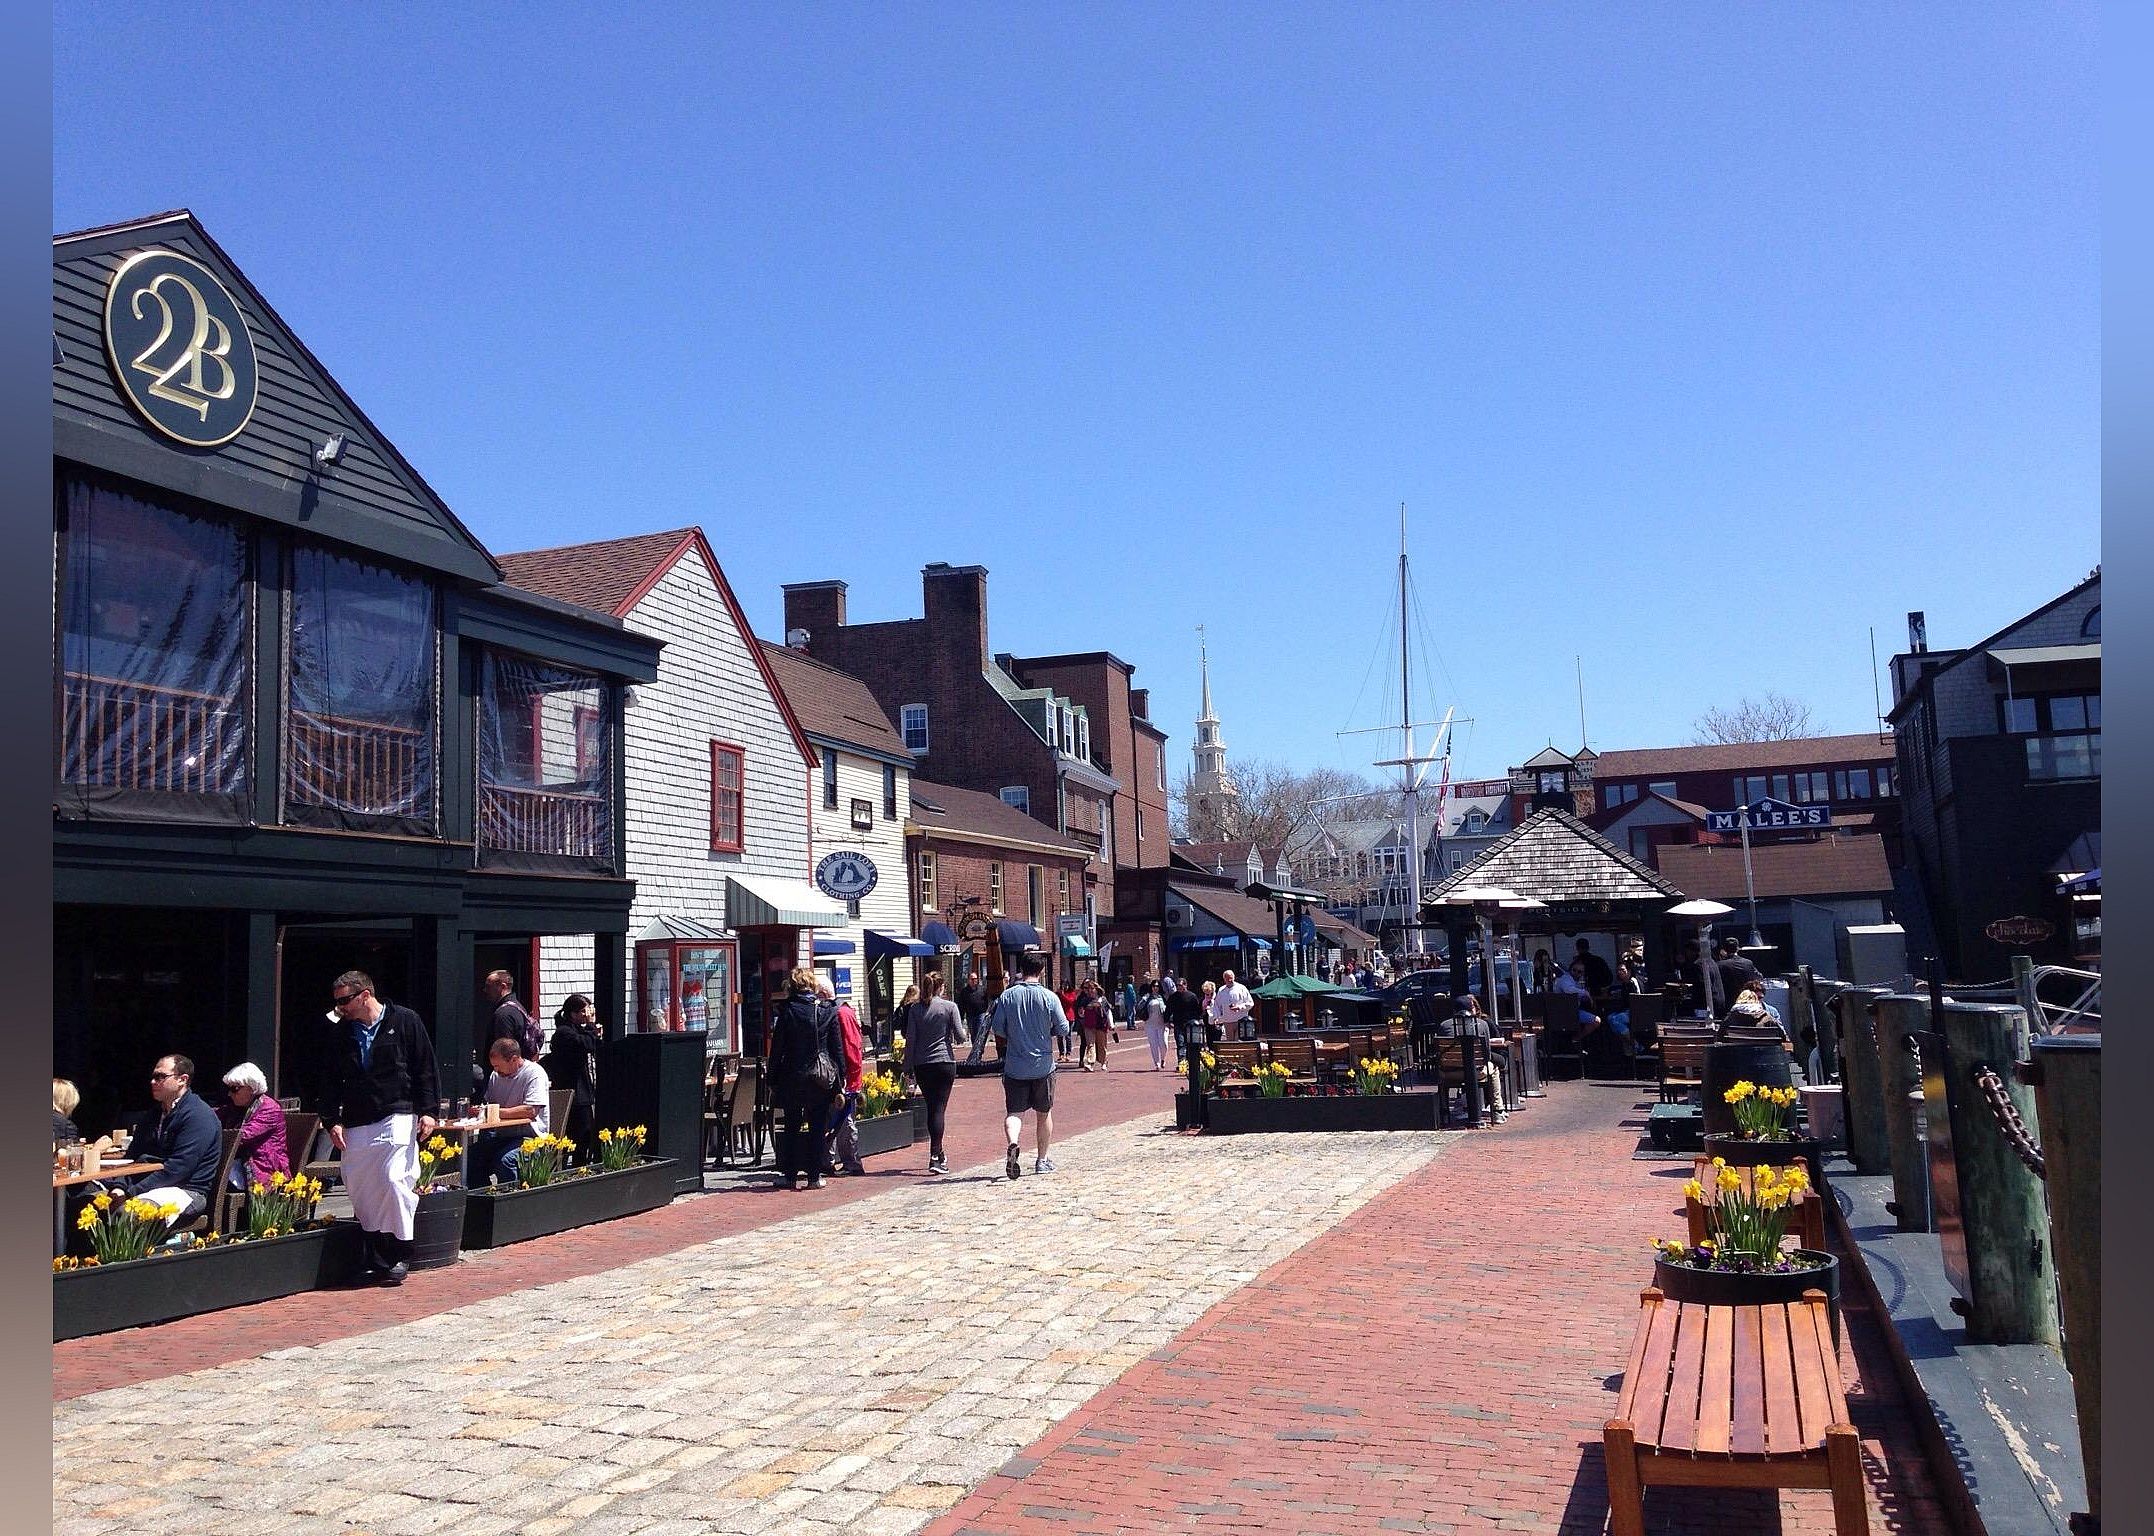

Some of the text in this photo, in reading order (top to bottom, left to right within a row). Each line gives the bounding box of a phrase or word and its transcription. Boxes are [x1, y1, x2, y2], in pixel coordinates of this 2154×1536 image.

[1716, 810, 1821, 829] MALEE'S
[818, 851, 876, 873] THE SAIL LOFT
[821, 883, 860, 900] CLOTHING
[876, 968, 888, 998] OPEN
